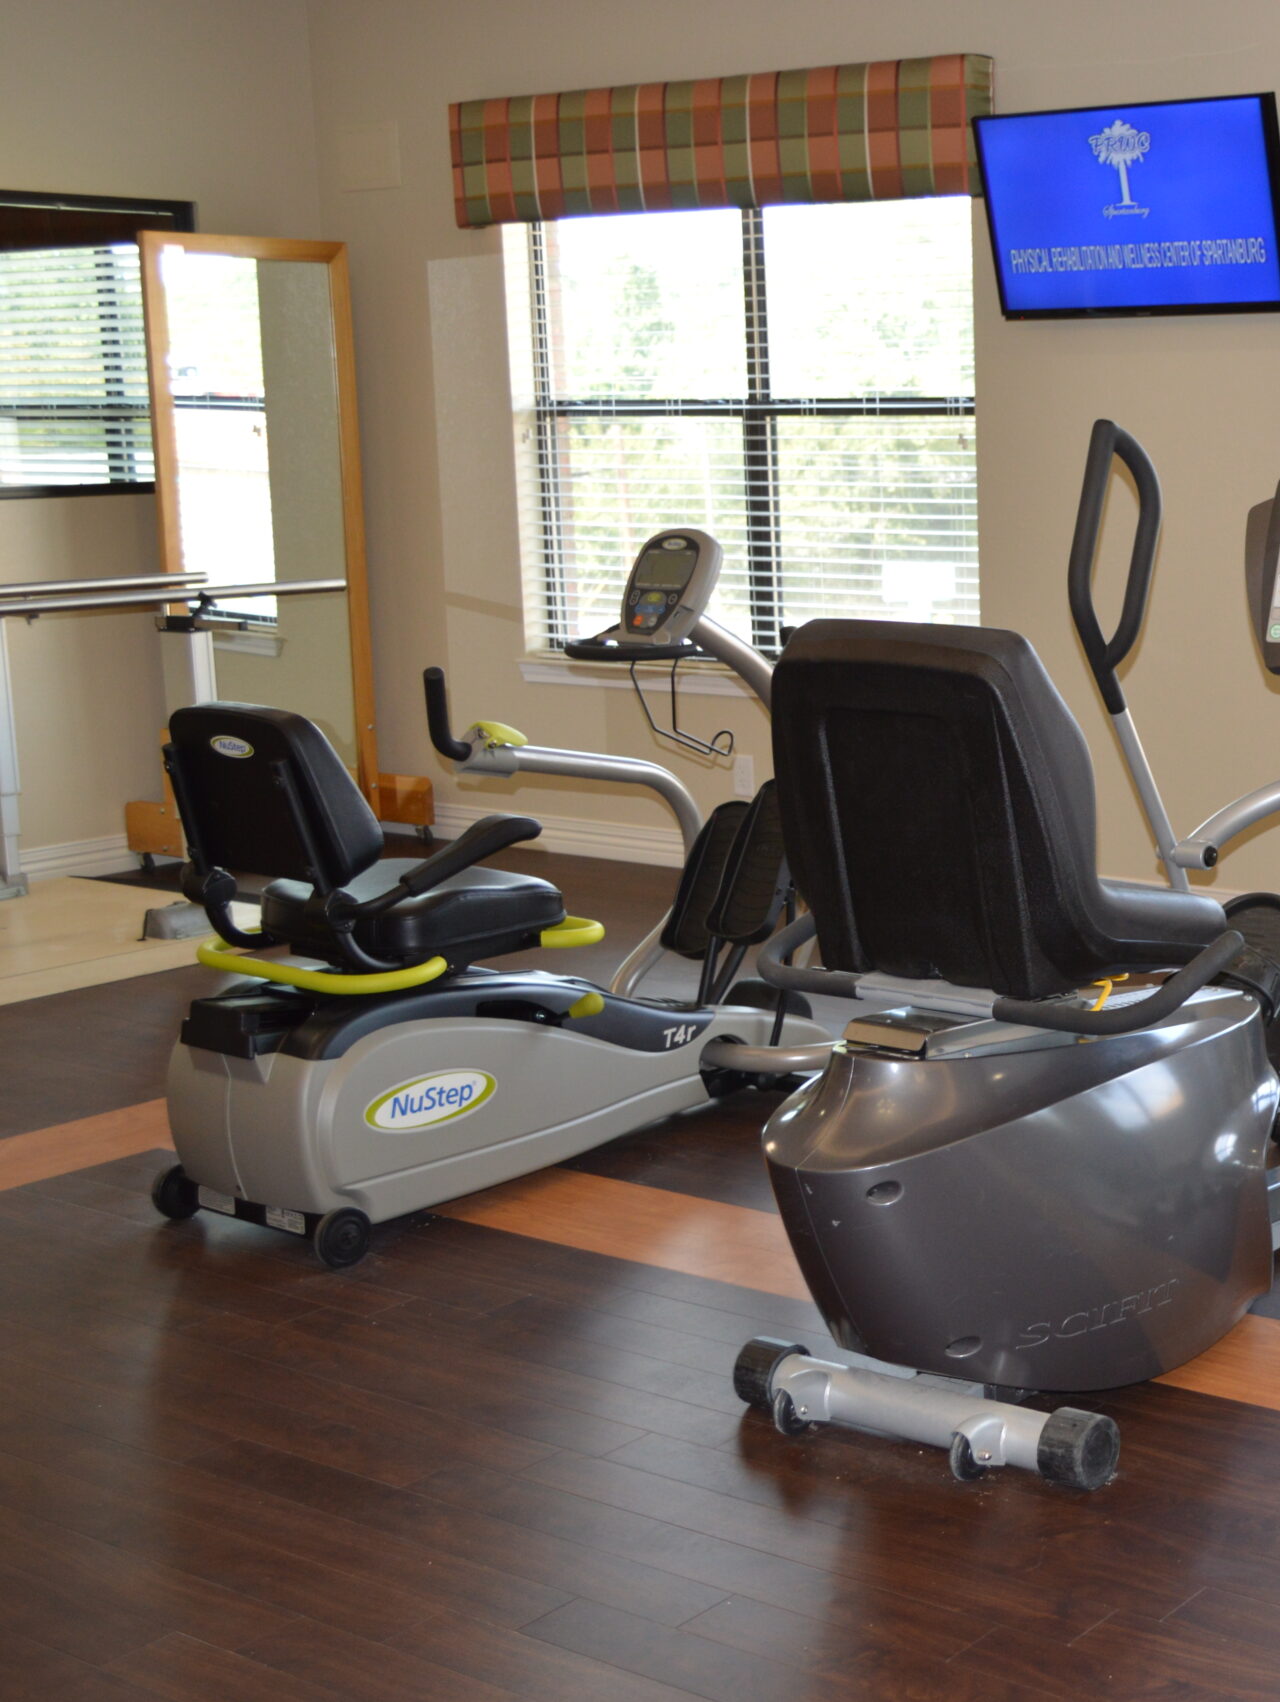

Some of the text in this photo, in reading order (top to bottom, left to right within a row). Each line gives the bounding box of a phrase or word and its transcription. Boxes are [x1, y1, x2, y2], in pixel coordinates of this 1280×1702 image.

[1010, 236, 1267, 275] PHYSICAL REHABILITATION AND WELLNESS CENTER OF SPARTANBURG
[663, 1024, 697, 1049] T4r
[390, 1083, 475, 1119] NuStep
[1015, 1278, 1179, 1350] SCIFIT
